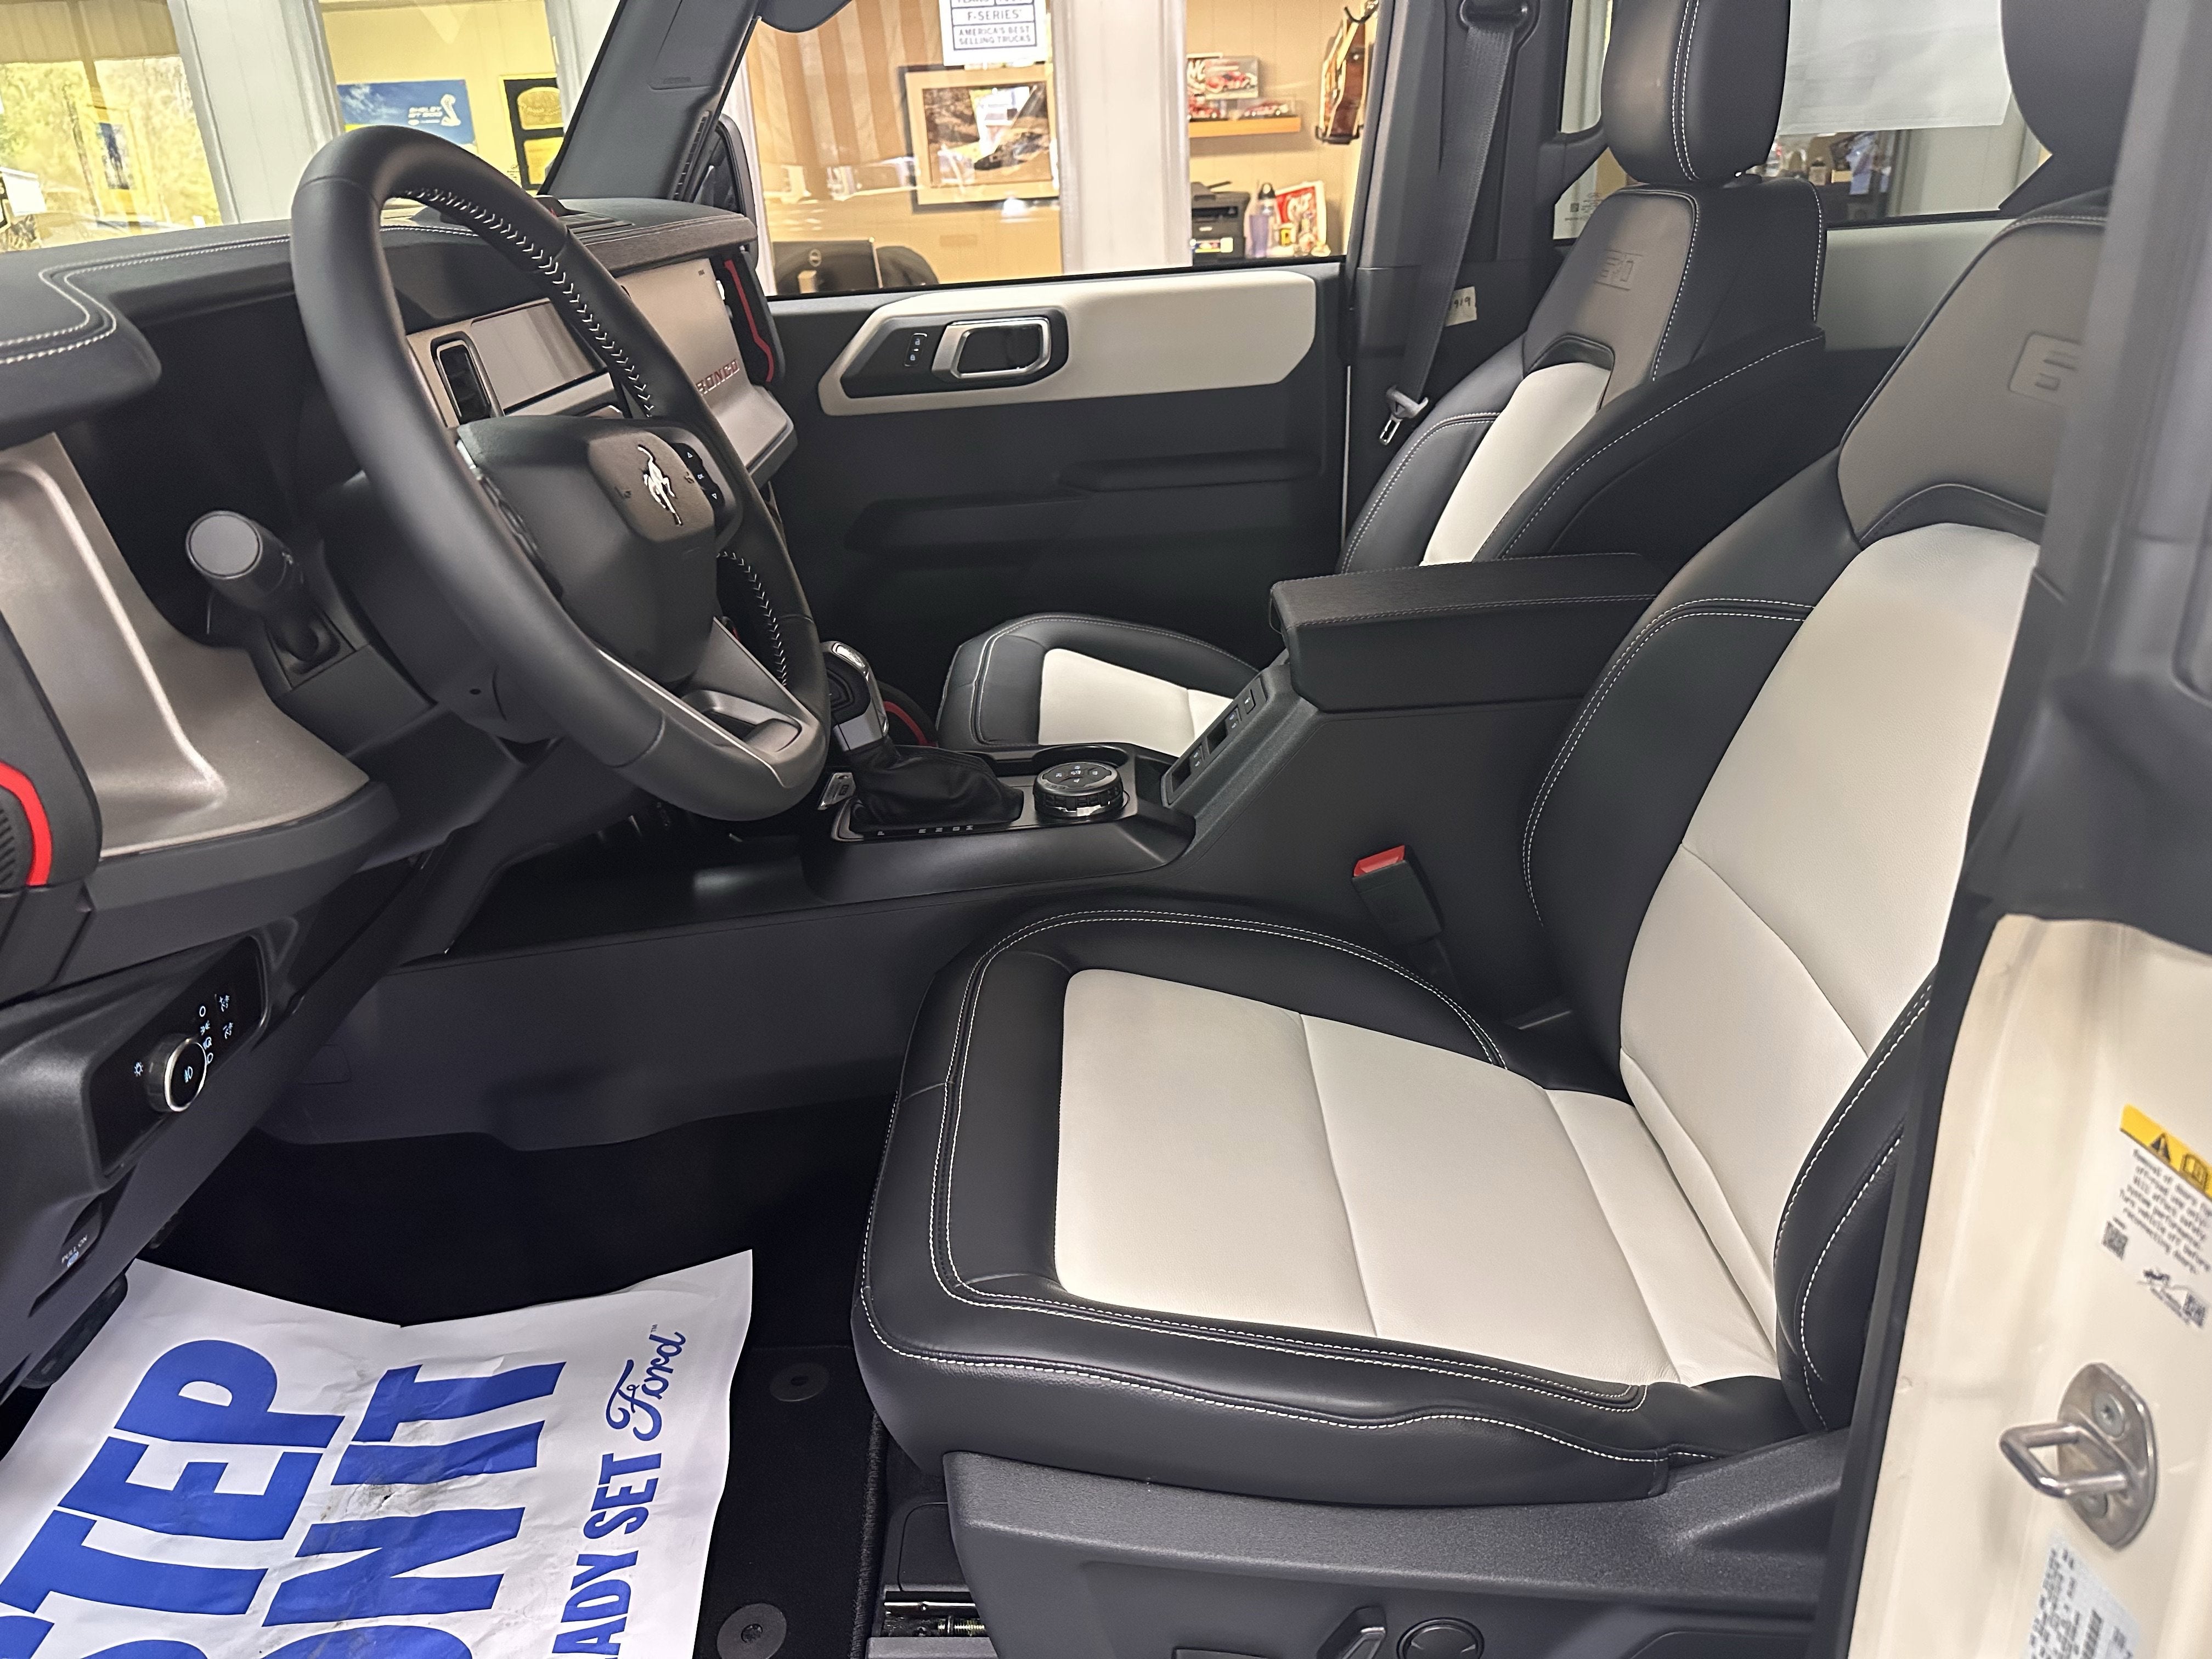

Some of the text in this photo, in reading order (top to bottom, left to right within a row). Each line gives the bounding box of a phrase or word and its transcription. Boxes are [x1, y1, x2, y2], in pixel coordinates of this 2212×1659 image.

[960, 35, 1031, 45] SELLING TRUCKS
[1008, 25, 1030, 34] BEST
[0, 1339, 345, 1659] TEP
[262, 1361, 567, 1659] N IT
[552, 1331, 686, 1659] ADY SET Ford
